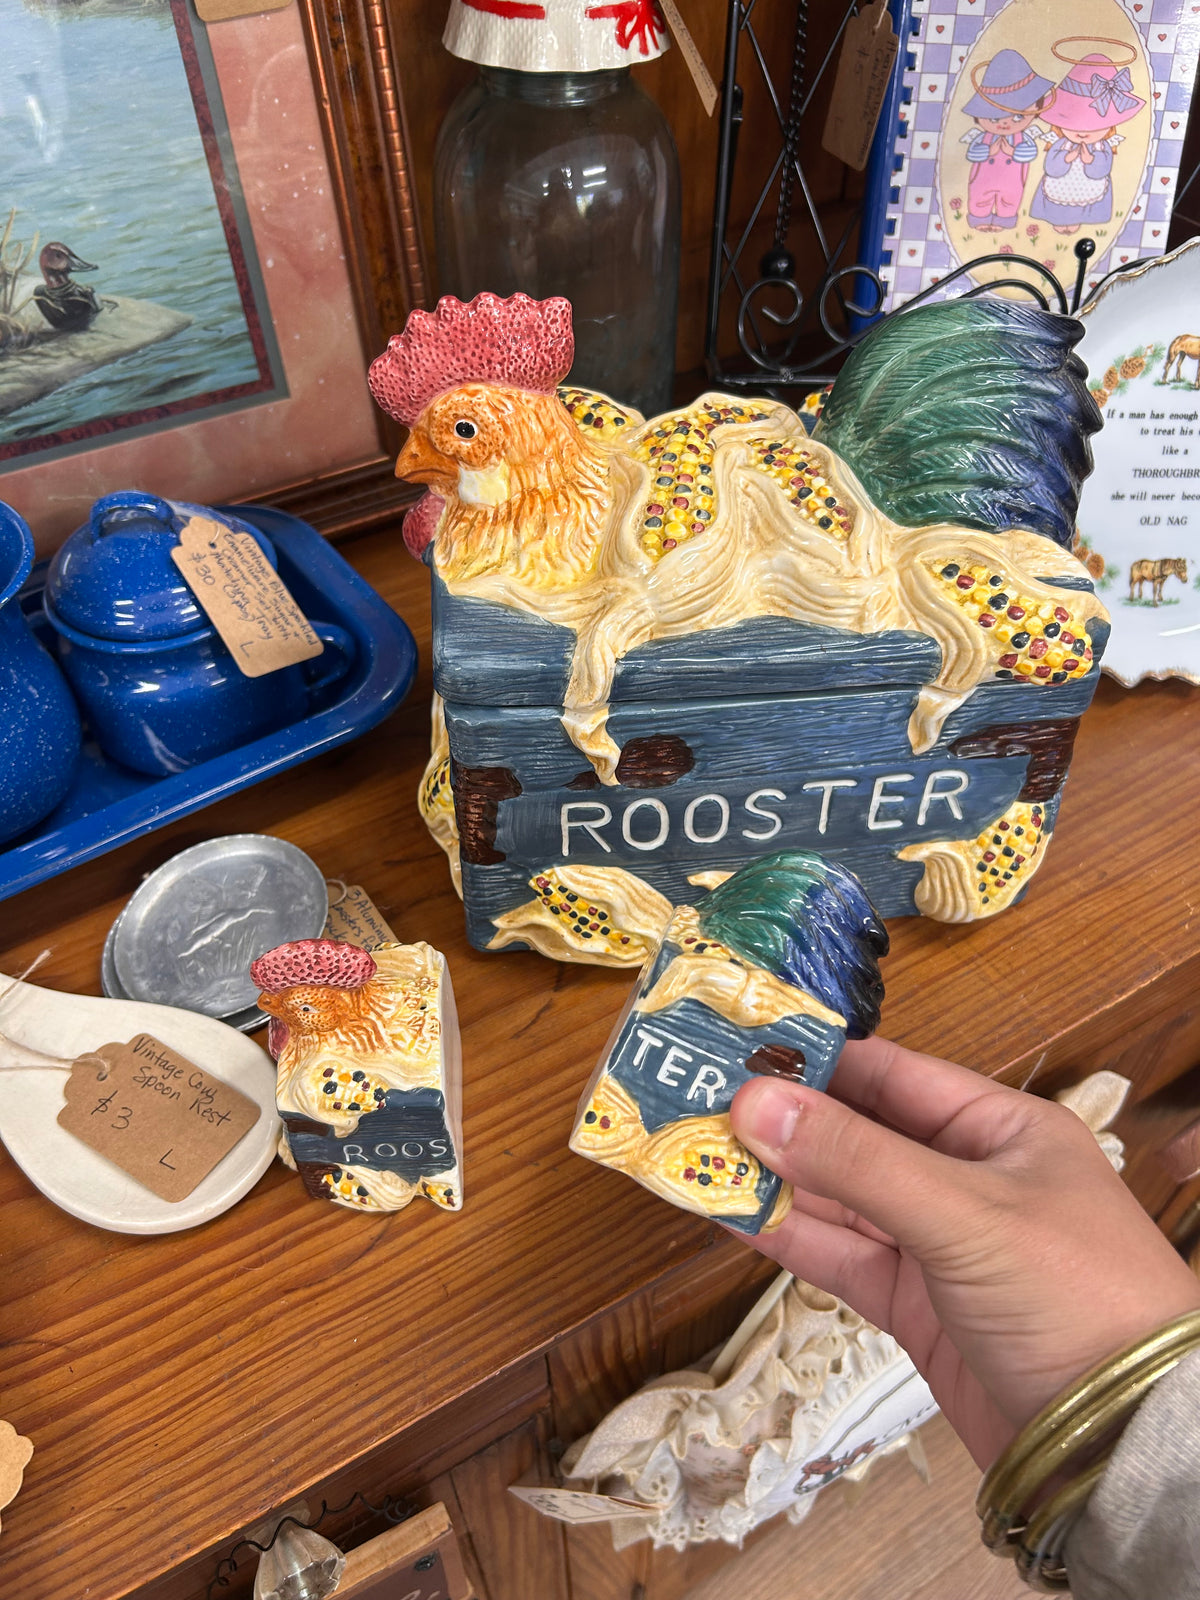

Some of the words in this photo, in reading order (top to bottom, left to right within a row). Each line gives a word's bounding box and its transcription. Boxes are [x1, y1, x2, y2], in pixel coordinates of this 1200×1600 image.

[1107, 409, 1115, 419] If
[1150, 410, 1165, 419] has
[1169, 410, 1199, 422] enough
[1140, 427, 1149, 436] to
[1154, 427, 1175, 436] treat
[1179, 427, 1193, 436] his
[1162, 446, 1179, 455] like
[1111, 491, 1125, 501] she
[1130, 491, 1147, 500] will
[1140, 516, 1160, 526] OLD
[1167, 516, 1188, 526] NAG
[188, 553, 216, 586] $30
[239, 537, 271, 580] Vintage
[268, 580, 290, 605] Blue
[253, 607, 274, 640] Tray
[269, 598, 293, 628] Sugar
[561, 770, 970, 857] ROOSTER
[133, 1037, 184, 1080] Vintage
[188, 1072, 217, 1099] Cow
[630, 1028, 728, 1109] TER
[133, 1066, 181, 1100] Spoon
[189, 1096, 231, 1126] Rest
[159, 1149, 176, 1171] L
[343, 1138, 449, 1163] ROOS
